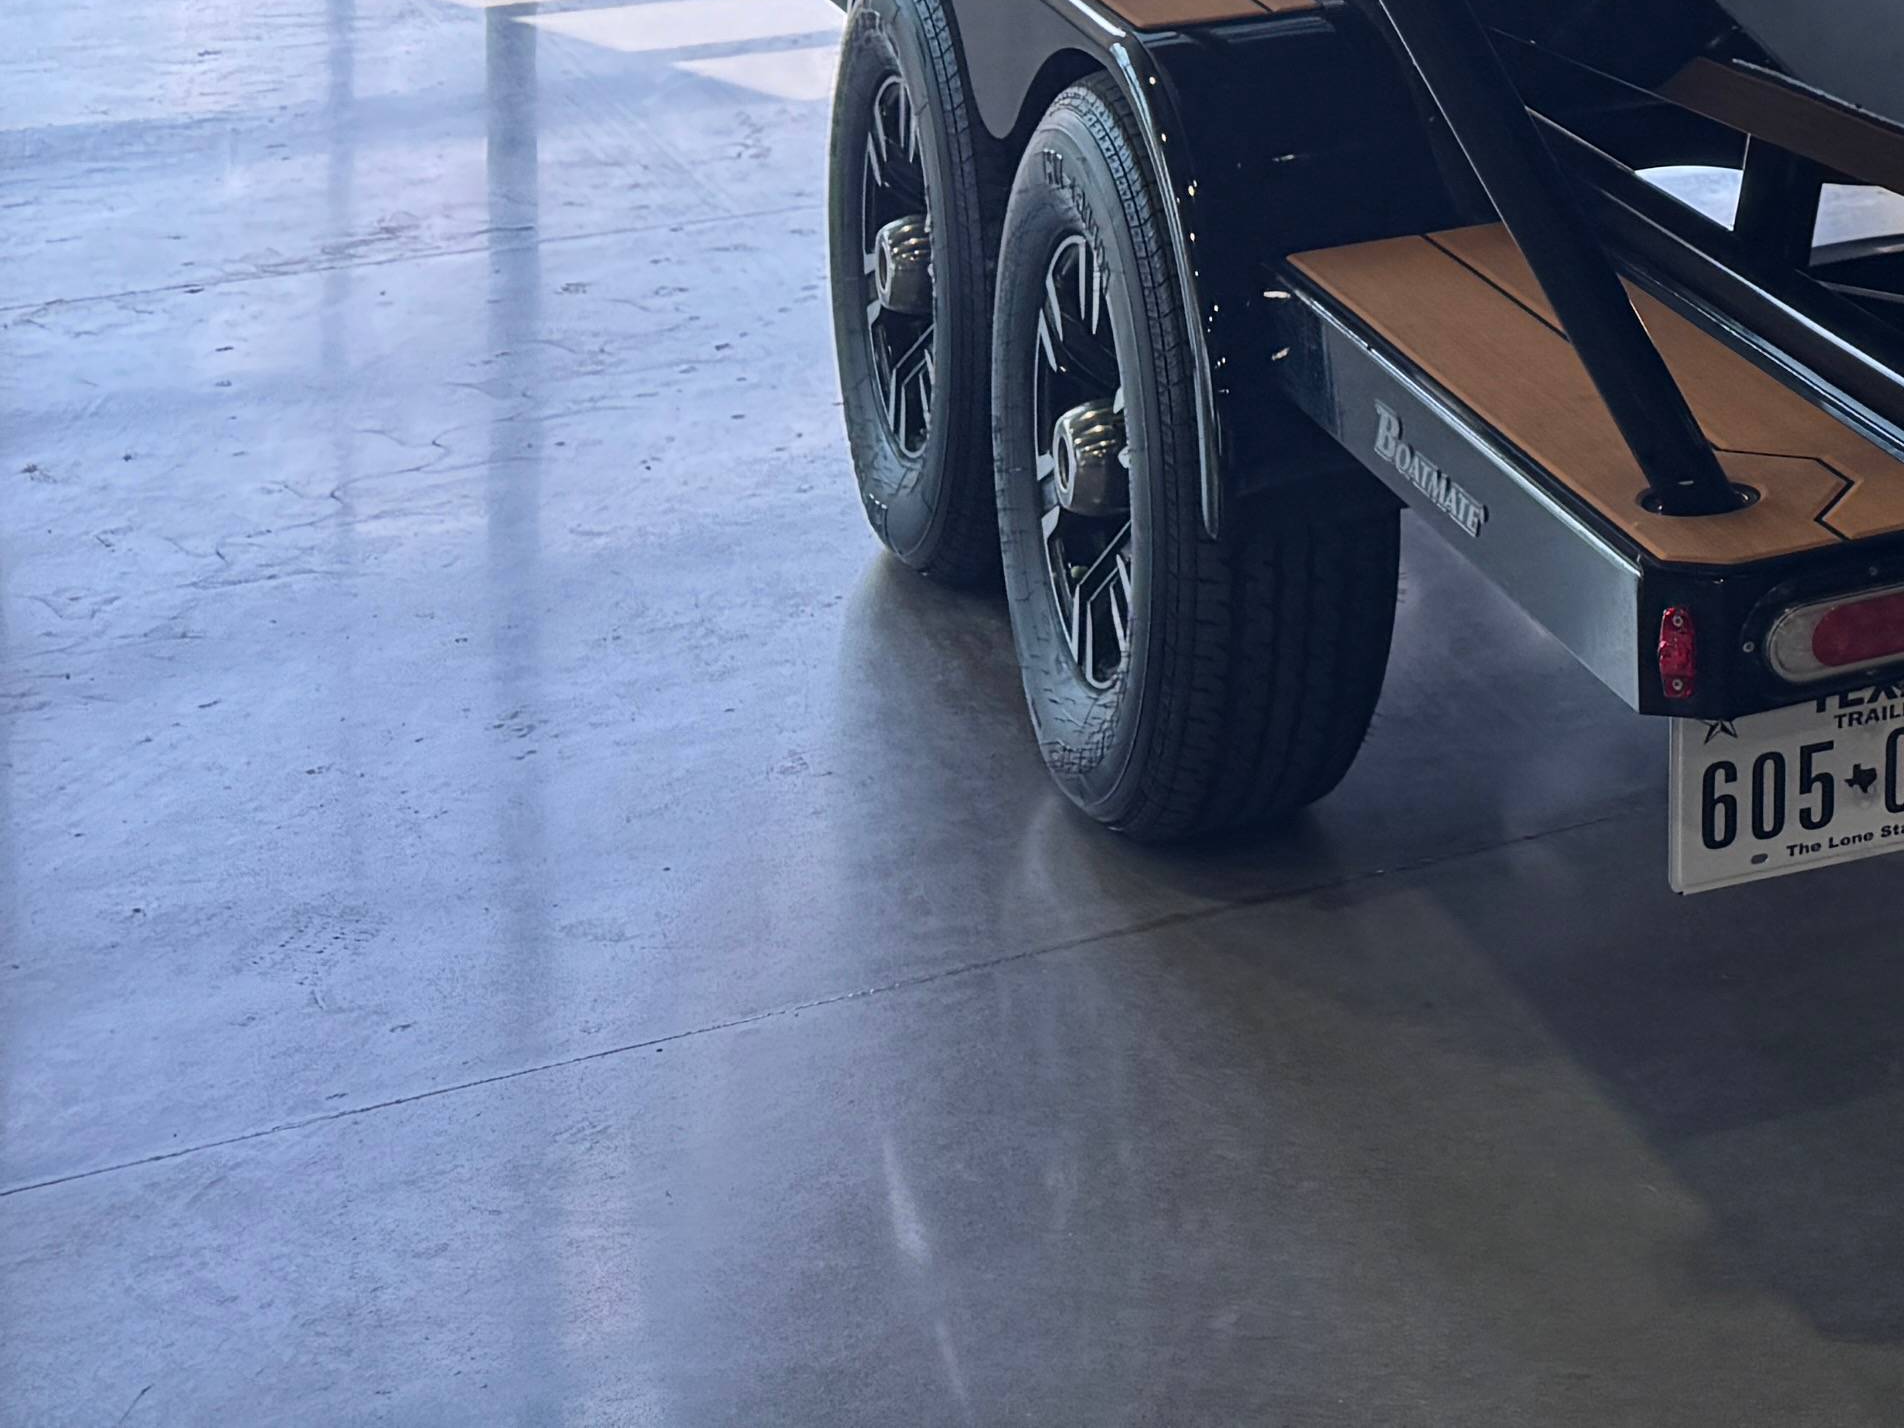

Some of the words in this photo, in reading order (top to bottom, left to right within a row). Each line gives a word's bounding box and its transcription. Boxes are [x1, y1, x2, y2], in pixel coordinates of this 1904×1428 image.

[1375, 400, 1485, 537] BOATMATE
[1786, 842, 1821, 857] The
[1828, 831, 1874, 850] Lone
